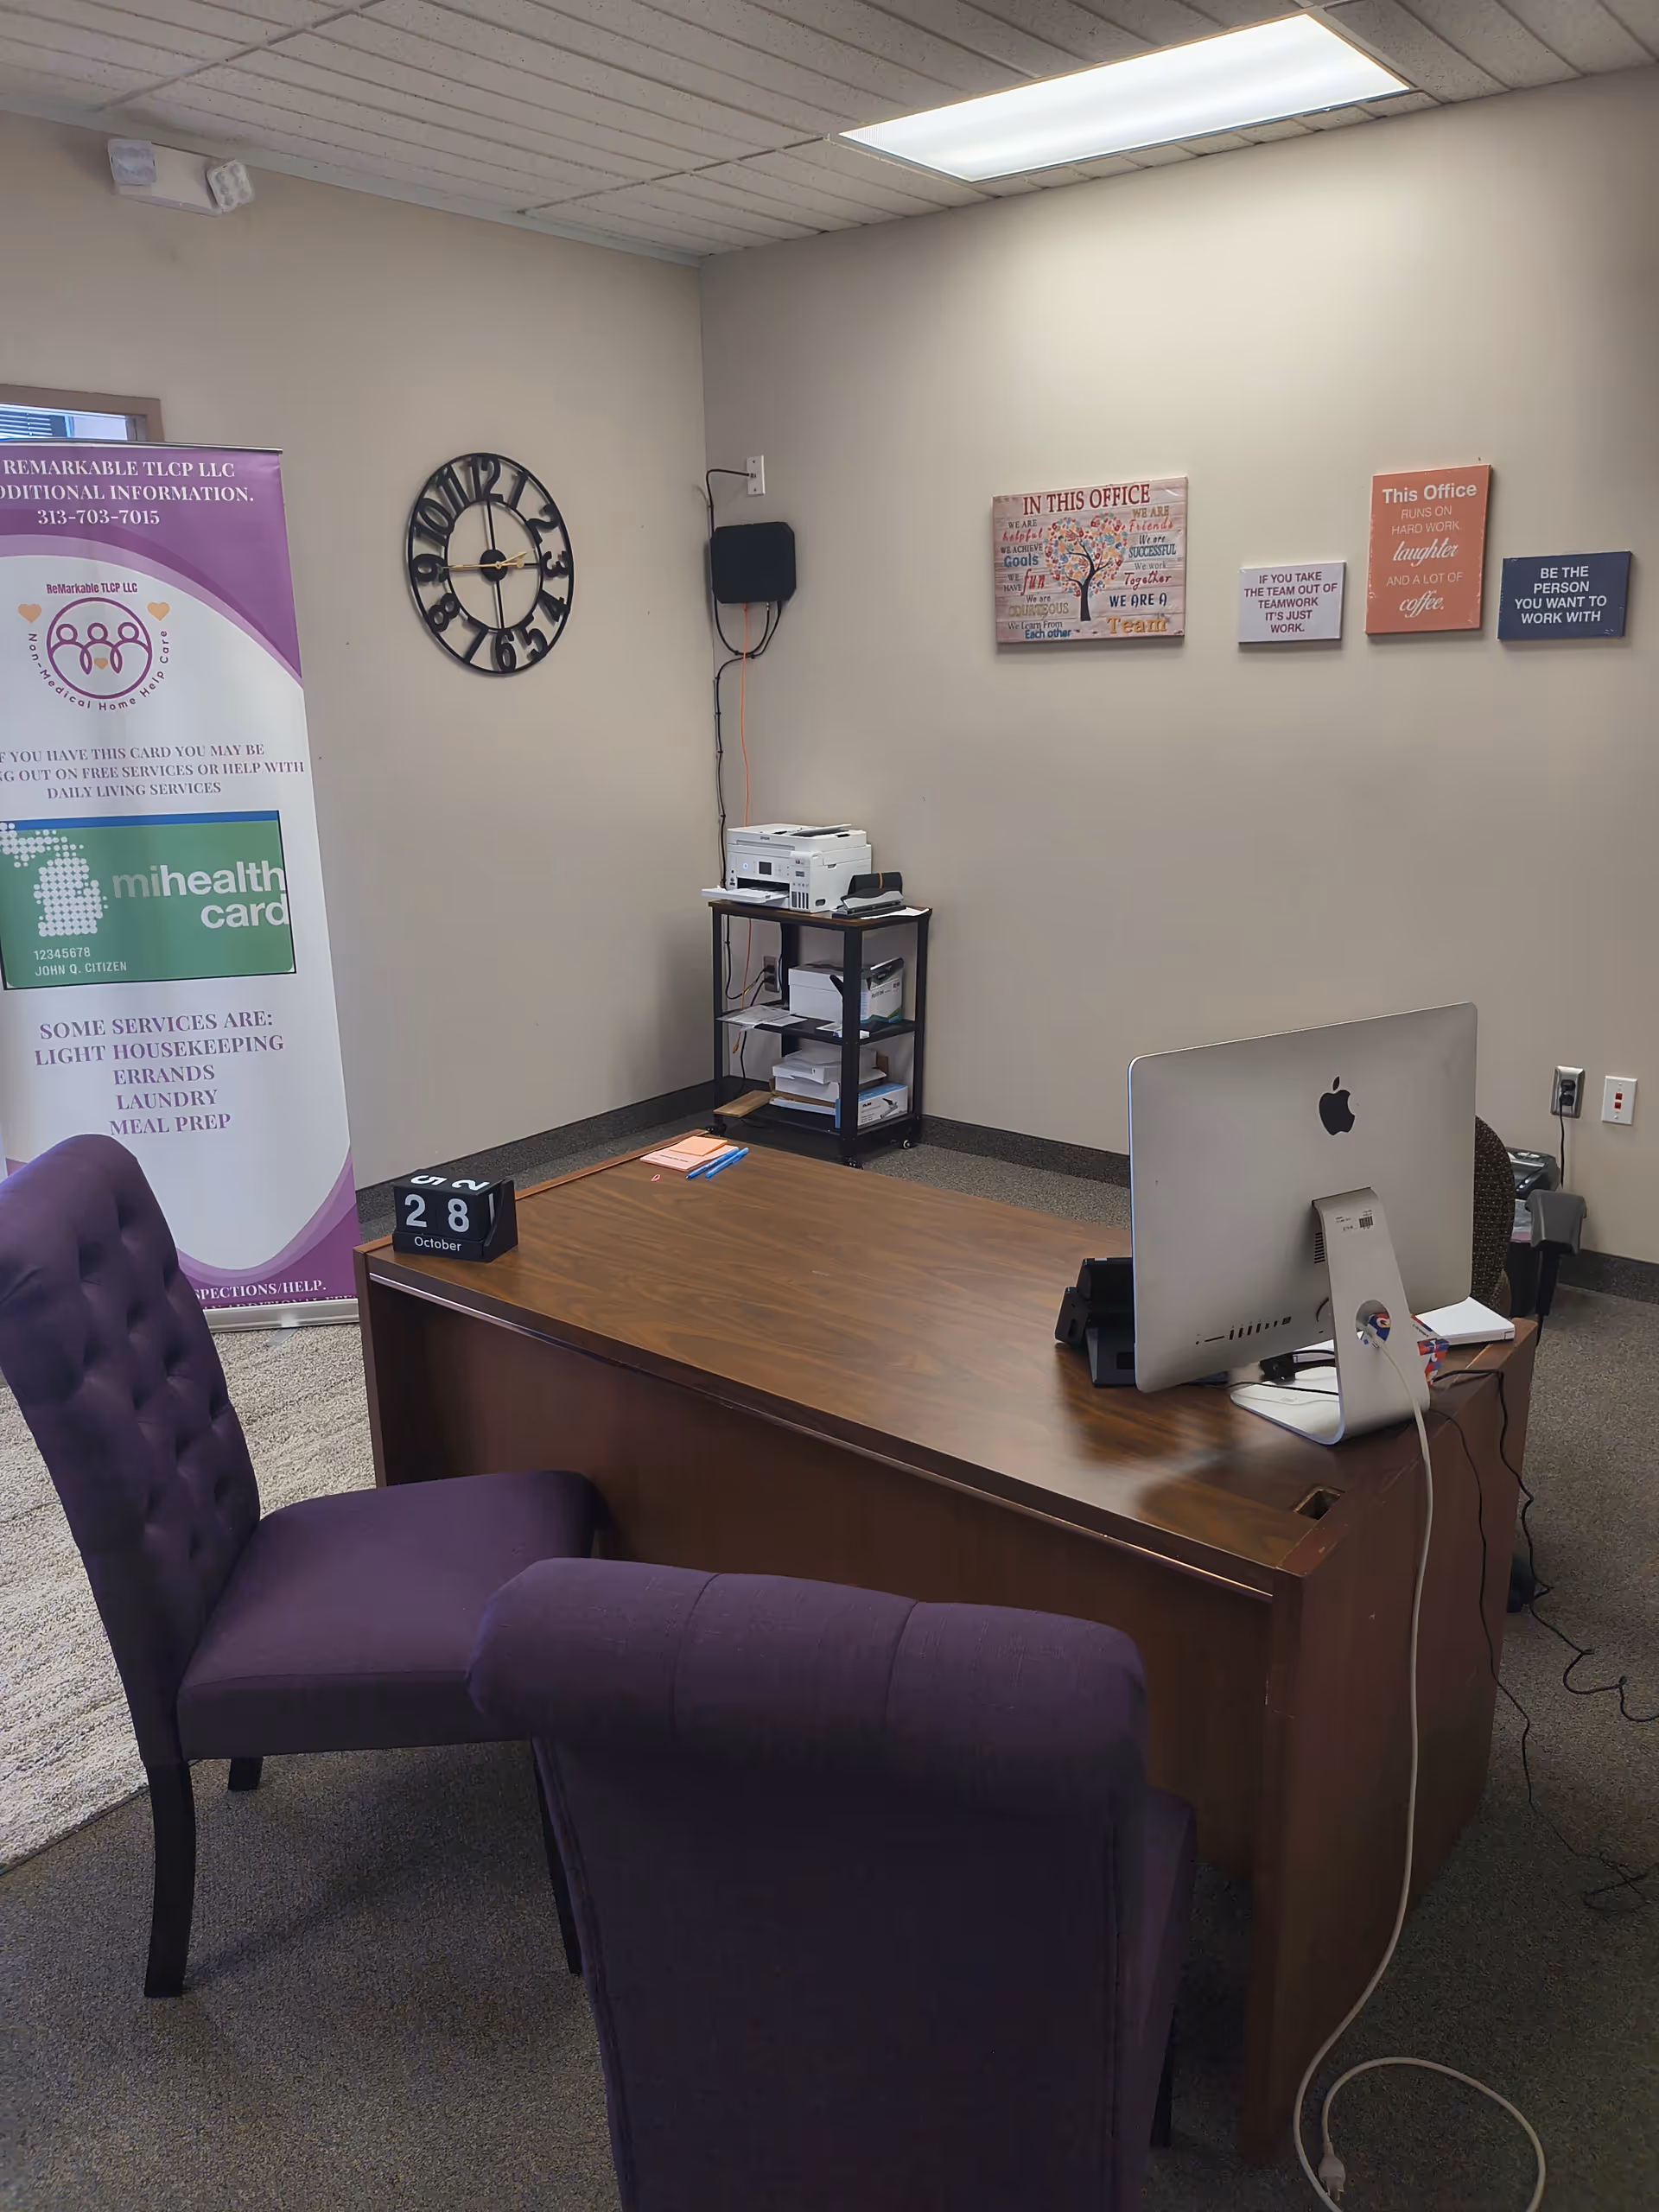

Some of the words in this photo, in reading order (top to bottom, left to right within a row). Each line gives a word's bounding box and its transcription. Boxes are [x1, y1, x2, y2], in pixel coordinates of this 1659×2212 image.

[3, 459, 138, 476] REMARKABLE
[143, 461, 194, 477] TLCP
[199, 462, 235, 478] LLC
[110, 485, 254, 502] INFORMATION.
[1023, 495, 1041, 516] IN
[1046, 491, 1084, 513] THIS
[1090, 484, 1150, 508] OFFICE
[1382, 486, 1418, 504] This
[1424, 483, 1477, 500] Office
[37, 509, 161, 525] 313-703-7015
[1133, 508, 1147, 518] WE
[1150, 505, 1170, 517] ARE
[1401, 507, 1432, 520] RUNS
[1434, 505, 1452, 517] ON
[1128, 517, 1173, 533] Friends
[1391, 524, 1422, 535] HARD
[1426, 520, 1462, 533] WORK.
[1002, 527, 1043, 543] helpful
[1140, 534, 1150, 544] We
[1013, 543, 1043, 554] ACHIEVE
[1128, 543, 1177, 559] SUCCESSFUL
[1392, 537, 1459, 567] laughter
[1003, 553, 1039, 568] Goals
[1148, 560, 1166, 569] work
[1007, 573, 1020, 582] WE
[1124, 570, 1173, 590] Together
[1259, 575, 1268, 584] IF
[1271, 573, 1292, 583] YOU
[1295, 571, 1322, 582] TAKE
[1387, 575, 1410, 587] AND
[1412, 574, 1421, 585] A
[1423, 573, 1445, 584] LOT
[1447, 571, 1464, 582] OF
[1540, 568, 1559, 579] BE
[1561, 565, 1589, 578] THE
[46, 583, 99, 594] ReMarkable
[101, 582, 121, 593] TLCP
[123, 582, 138, 593] LLC
[1020, 569, 1046, 596] fun
[1244, 588, 1264, 597] THE
[1267, 586, 1295, 596] TEAM
[1298, 584, 1319, 594] OUT
[1323, 582, 1338, 593] OF
[1534, 581, 1590, 594] PERSON
[1109, 594, 1127, 607] WE
[1130, 593, 1154, 607] ARE
[1159, 592, 1167, 607] A
[1258, 597, 1319, 608] TEAMWORK
[1399, 589, 1445, 619] coffee.
[1515, 598, 1542, 609] YOU
[1546, 596, 1586, 609] WANT
[1588, 594, 1607, 607] TO
[1008, 603, 1069, 617] COURTEOUS
[1265, 612, 1284, 621] IT'S
[1286, 609, 1313, 620] JUST
[1521, 612, 1563, 624] WORK
[1566, 610, 1601, 623] WITH
[1008, 621, 1020, 630] We
[1021, 621, 1042, 631] Learn
[1043, 620, 1063, 629] From
[1025, 629, 1046, 639] Each
[1047, 627, 1071, 639] other
[1106, 616, 1166, 634] Team
[1270, 623, 1305, 633] WORK.
[29, 633, 91, 709] Non-Medical
[99, 697, 137, 711] Home
[139, 671, 165, 698] Help
[159, 630, 170, 664] Care
[10, 750, 42, 763] YOU
[47, 748, 88, 762] HAVE
[91, 747, 126, 760] THIS
[130, 746, 171, 760] CARD
[175, 745, 206, 758] YOU
[210, 744, 241, 757] MAY
[245, 743, 265, 756] BE
[19, 768, 52, 782] OUT
[55, 767, 79, 780] ON
[82, 766, 119, 779] FREE
[122, 764, 194, 779] SERVICES
[197, 763, 219, 776] OR
[223, 762, 261, 775] HELP
[264, 761, 305, 773] WITH
[47, 786, 92, 799] DAILY
[97, 784, 146, 798] LIVING
[149, 781, 221, 796] SERVICES
[111, 860, 286, 899] mihealth
[200, 893, 290, 930] card
[34, 946, 91, 961] 12345678
[35, 963, 66, 976] JOHN
[69, 963, 82, 975] Q.
[85, 961, 127, 973] CITIZEN
[39, 1020, 106, 1040] SOME
[111, 1014, 218, 1035] SERVICES
[224, 1010, 273, 1029] ARE:
[35, 1045, 105, 1066] LIGHT
[112, 1034, 284, 1060] HOUSEKEEPING
[112, 1064, 215, 1085] ERRANDS
[116, 1089, 218, 1110] LAUNDRY
[109, 1117, 170, 1136] MEAL
[175, 1113, 231, 1132] PREP
[414, 1236, 462, 1252] October
